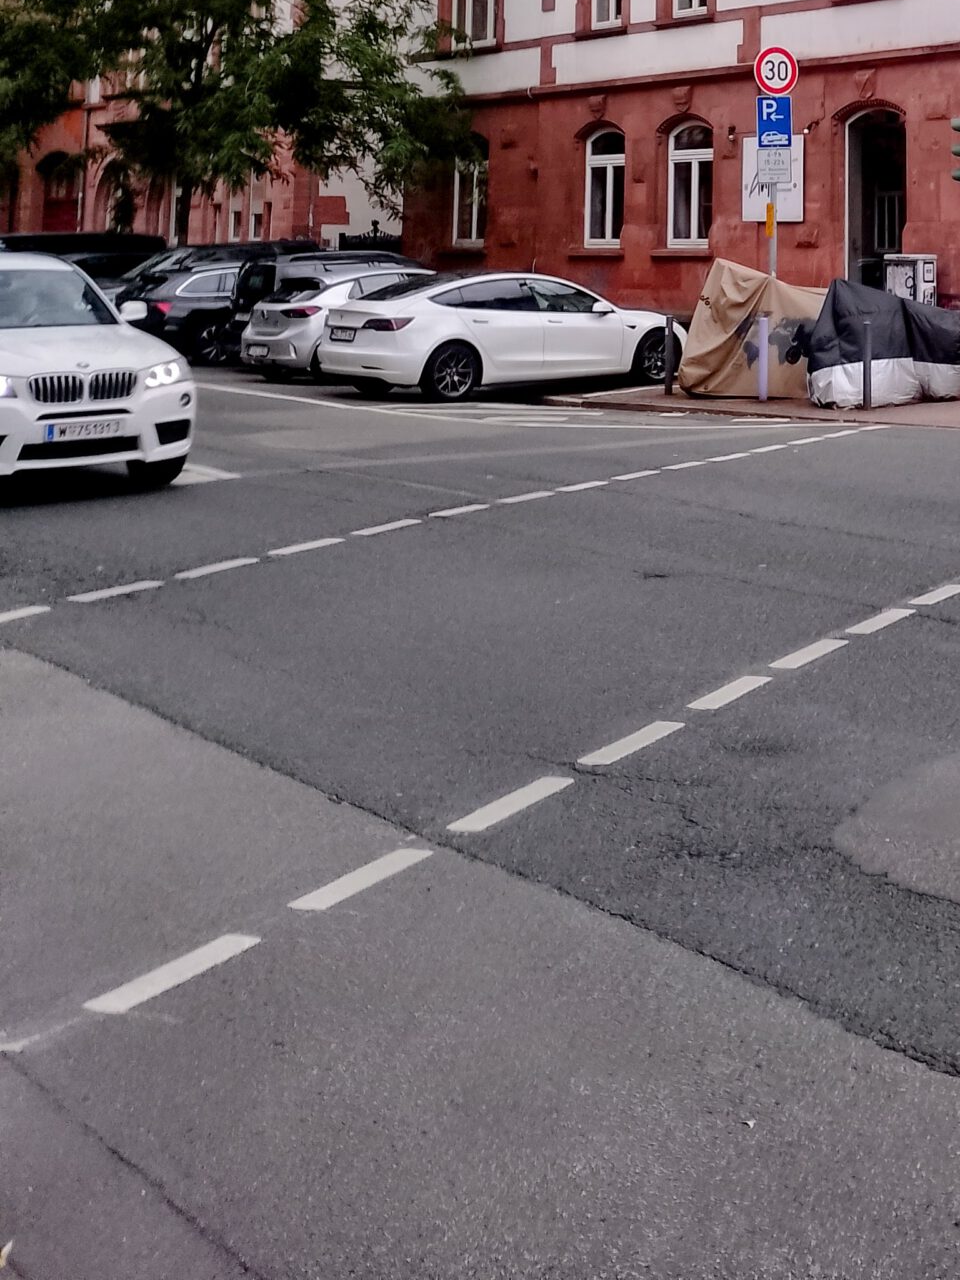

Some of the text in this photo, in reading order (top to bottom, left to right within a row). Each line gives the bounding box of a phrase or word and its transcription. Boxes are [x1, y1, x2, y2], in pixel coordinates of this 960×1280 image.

[765, 60, 788, 81] 30
[762, 99, 777, 120] P
[59, 426, 67, 438] W
